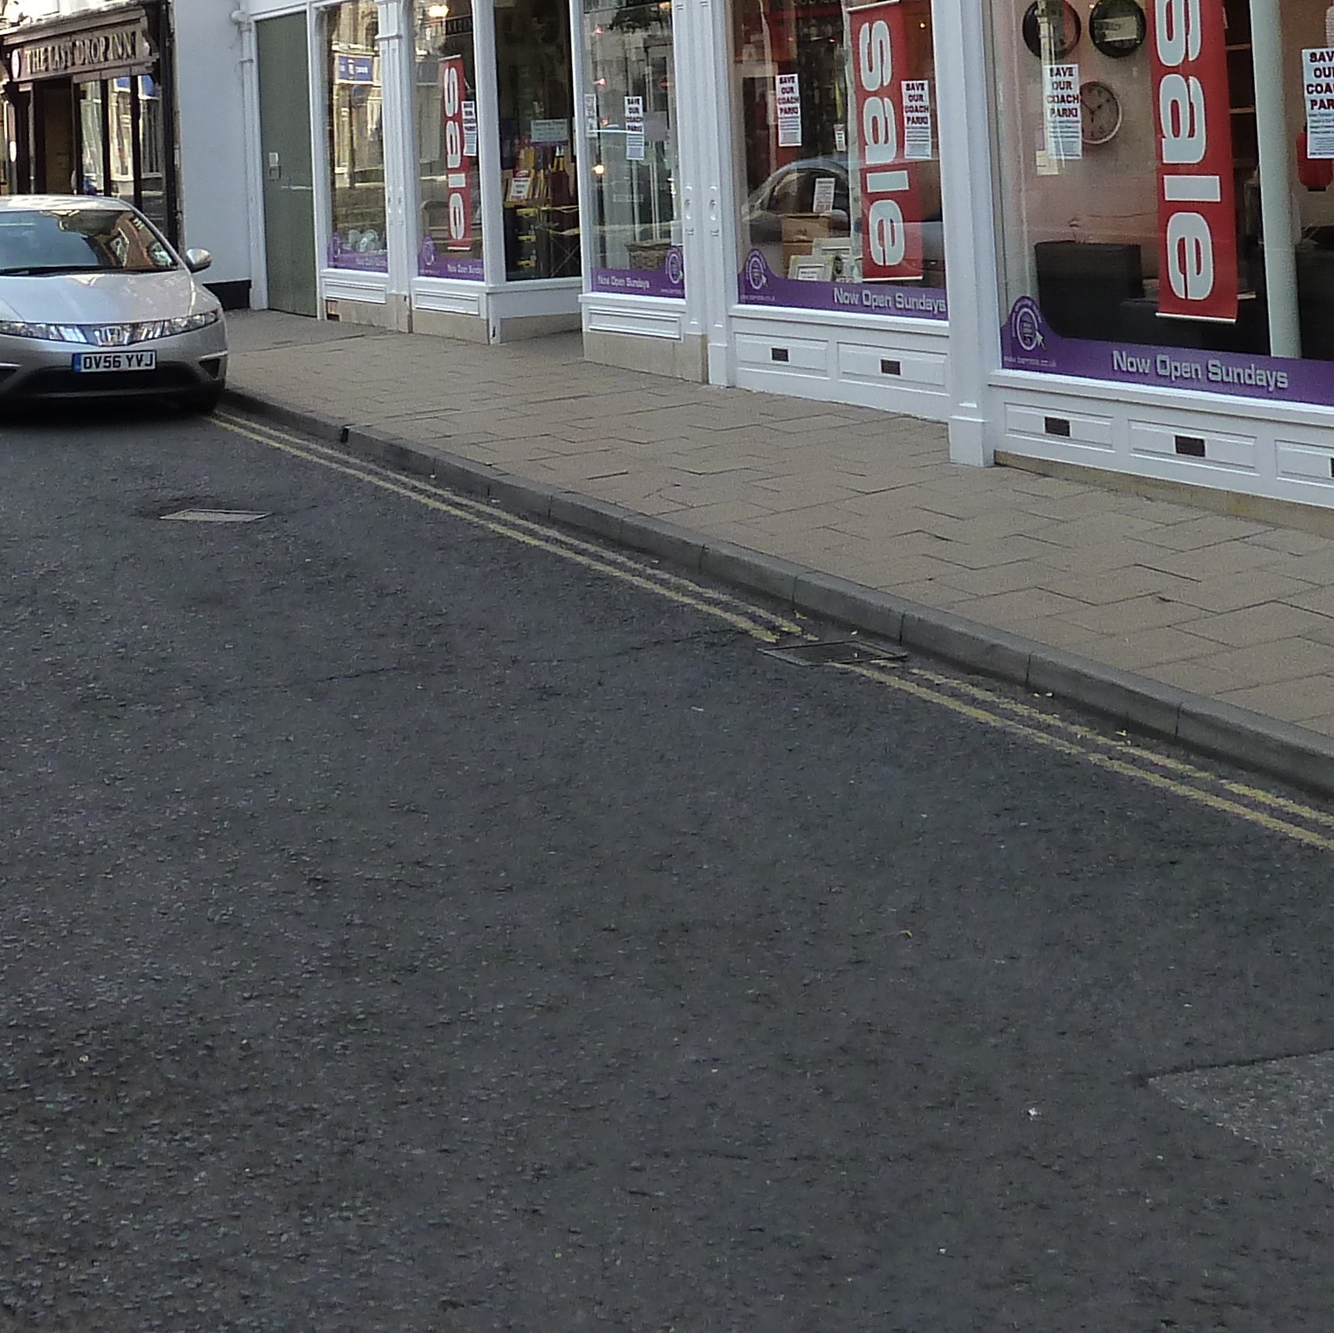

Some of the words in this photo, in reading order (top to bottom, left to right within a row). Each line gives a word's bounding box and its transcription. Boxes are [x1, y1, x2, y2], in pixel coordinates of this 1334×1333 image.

[24, 47, 48, 74] THE
[72, 36, 108, 66] DROP
[108, 30, 137, 61] INN
[1047, 94, 1079, 104] COACH
[859, 20, 908, 266] sale
[833, 287, 859, 306] Now
[862, 290, 892, 310] Open
[896, 292, 946, 314] Sundays
[125, 353, 153, 368] YVJ
[1113, 350, 1151, 373] Now
[1156, 355, 1201, 381] Open
[1208, 359, 1288, 391] Sundays
